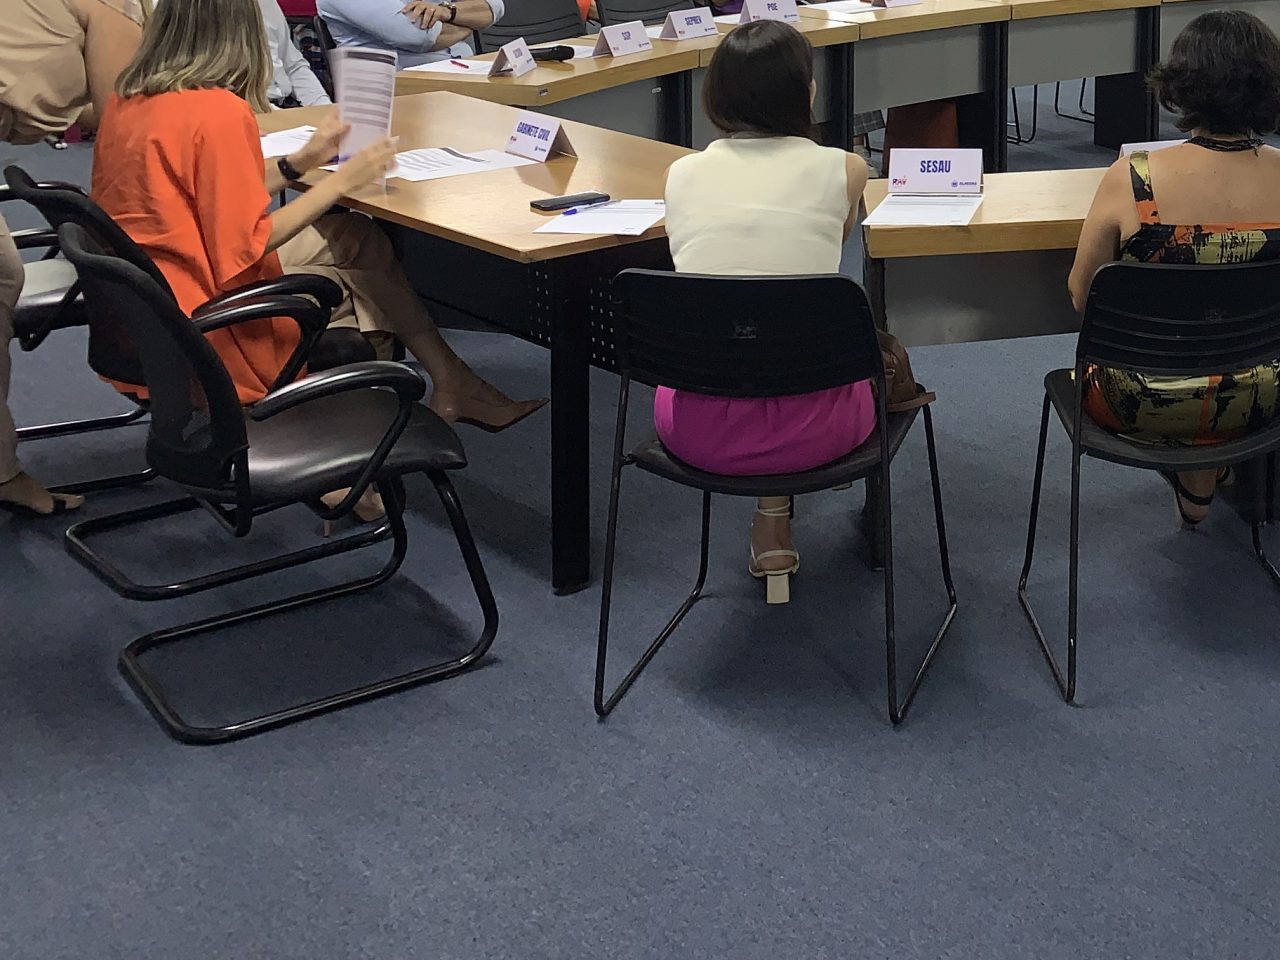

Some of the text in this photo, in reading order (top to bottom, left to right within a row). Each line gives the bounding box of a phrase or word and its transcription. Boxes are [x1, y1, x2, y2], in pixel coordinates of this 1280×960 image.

[517, 121, 551, 141] GABINETE CIVIL
[920, 160, 951, 173] SESAU
